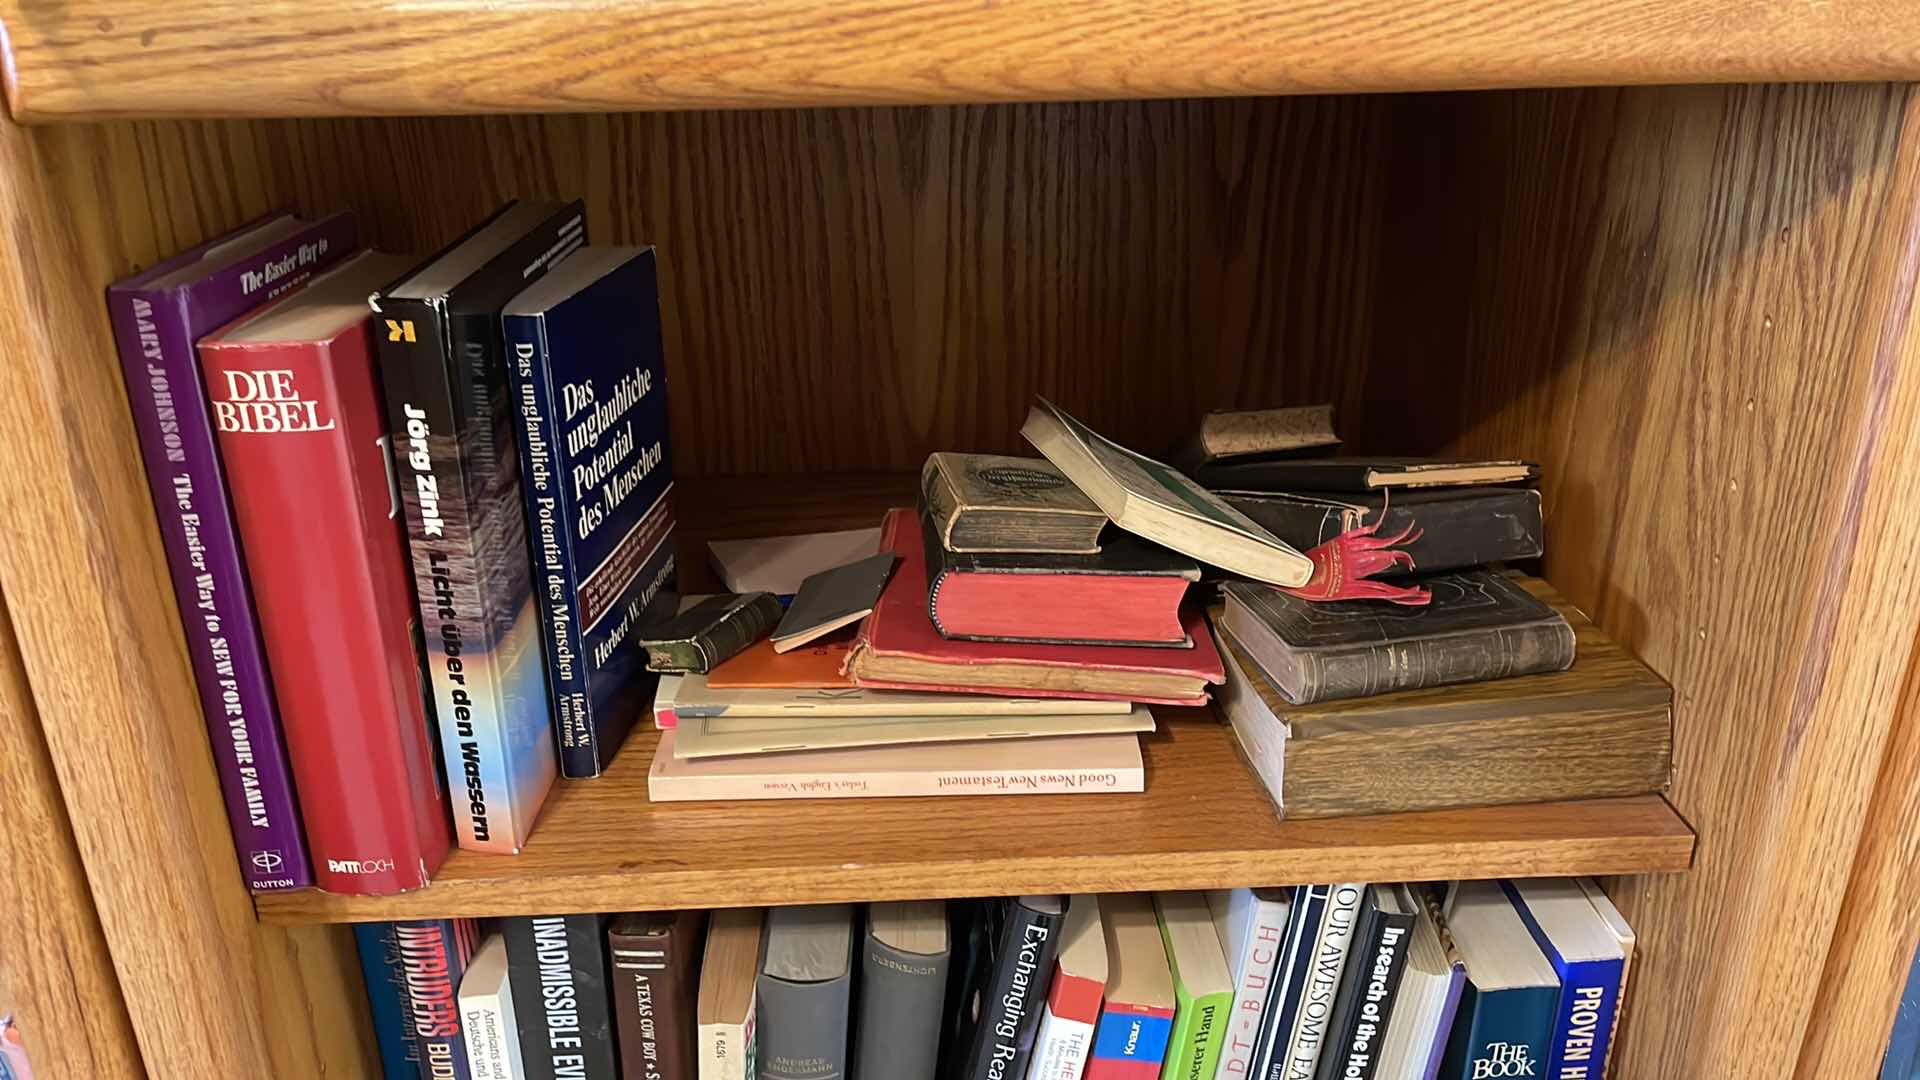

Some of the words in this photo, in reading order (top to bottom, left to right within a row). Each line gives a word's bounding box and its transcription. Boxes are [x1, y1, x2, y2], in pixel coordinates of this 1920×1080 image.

[240, 271, 263, 295] The
[132, 298, 164, 361] MARY
[515, 342, 533, 377] Das
[222, 369, 300, 401] DIE
[562, 378, 594, 422] Das
[147, 363, 186, 462] JOHNSON
[212, 400, 335, 433] BIBEL
[567, 366, 651, 457] unglaubliche
[404, 403, 432, 471] Jörg
[521, 383, 551, 491] unglaubliche
[572, 420, 634, 502] Potential
[173, 472, 193, 511] The
[415, 474, 444, 538] Zink
[578, 501, 603, 540] des
[602, 440, 662, 517] Menschen
[181, 513, 206, 571] Easier
[537, 497, 564, 570] Potential
[195, 573, 216, 611] Way
[429, 553, 456, 620] Licht
[547, 575, 565, 601] des
[204, 614, 221, 633] to
[551, 604, 575, 681] Menschen
[594, 614, 628, 669] Herbert
[210, 637, 235, 677] SEW
[441, 624, 465, 686] über
[219, 679, 243, 716] FOR
[451, 689, 473, 737] den
[571, 693, 586, 731] Herbert
[229, 717, 253, 765] YOUR
[559, 693, 574, 748] Armstrong
[239, 766, 270, 828] FAMILY
[461, 741, 490, 842] Wassern
[938, 775, 1009, 789] Testament
[1008, 774, 1039, 788] New
[1039, 774, 1076, 788] News
[1079, 773, 1117, 787] Good
[253, 878, 294, 889] DUTTON
[1325, 887, 1359, 938] OUR
[396, 926, 459, 1037] INTRUDERS
[532, 917, 582, 1049] INADMISSIBLE
[634, 974, 649, 983] A
[995, 923, 1049, 1038] Exchanging
[1298, 943, 1343, 1051] AWESOME
[636, 984, 653, 1017] TEXAS
[1361, 1002, 1381, 1023] of
[467, 1010, 484, 1057] Deutsche
[483, 1008, 501, 1060] Americans
[492, 1062, 507, 1080] and
[1195, 1004, 1216, 1046] Hand
[1352, 1023, 1377, 1053] the
[1563, 986, 1604, 1061] PROVEN
[427, 1043, 456, 1080] BUD
[642, 1041, 657, 1061] BOY
[987, 1043, 1016, 1080] Rea
[1066, 1033, 1084, 1058] THE
[1486, 1041, 1529, 1062] THE
[475, 1058, 490, 1078] und
[1472, 1058, 1537, 1080] BOOK
[1560, 1066, 1589, 1080] H
